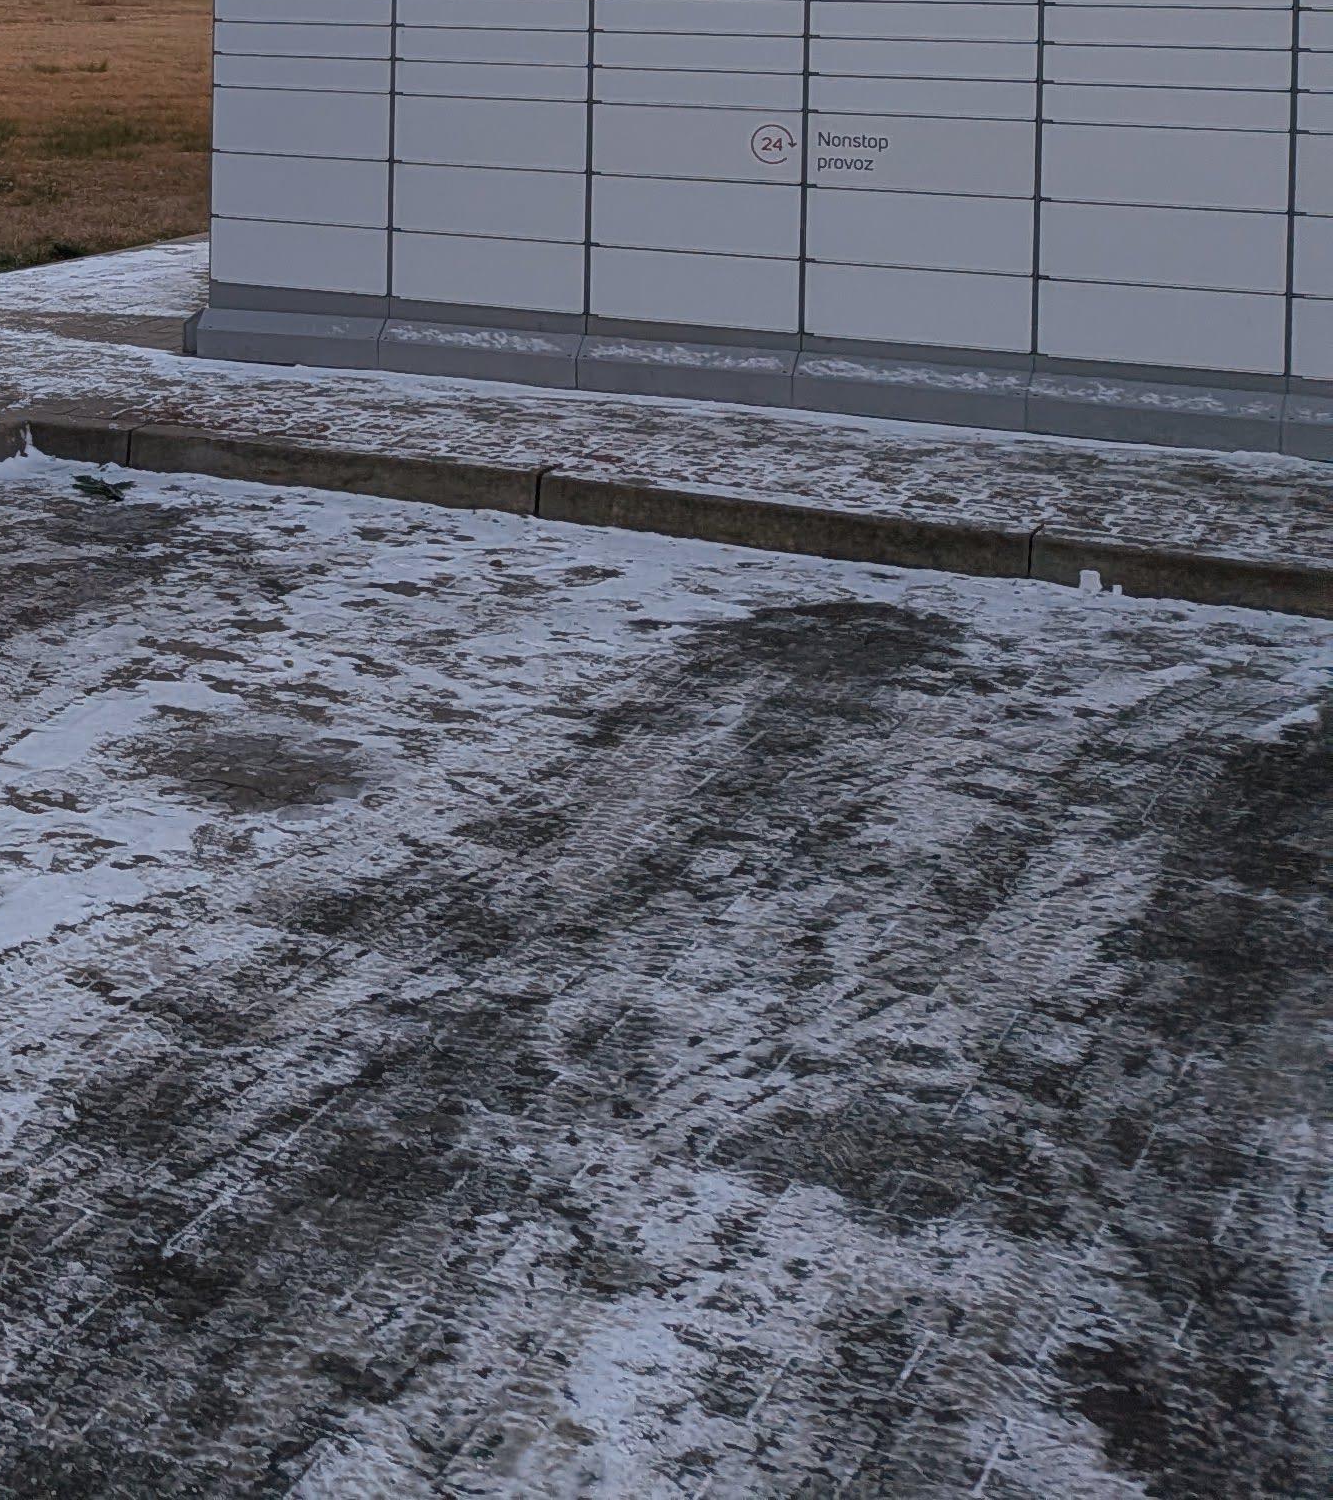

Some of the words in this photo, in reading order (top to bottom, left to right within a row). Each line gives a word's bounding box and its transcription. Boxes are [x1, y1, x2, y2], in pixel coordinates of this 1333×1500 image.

[761, 136, 783, 151] 24
[817, 131, 889, 152] Nonstop
[817, 156, 875, 172] provoz
